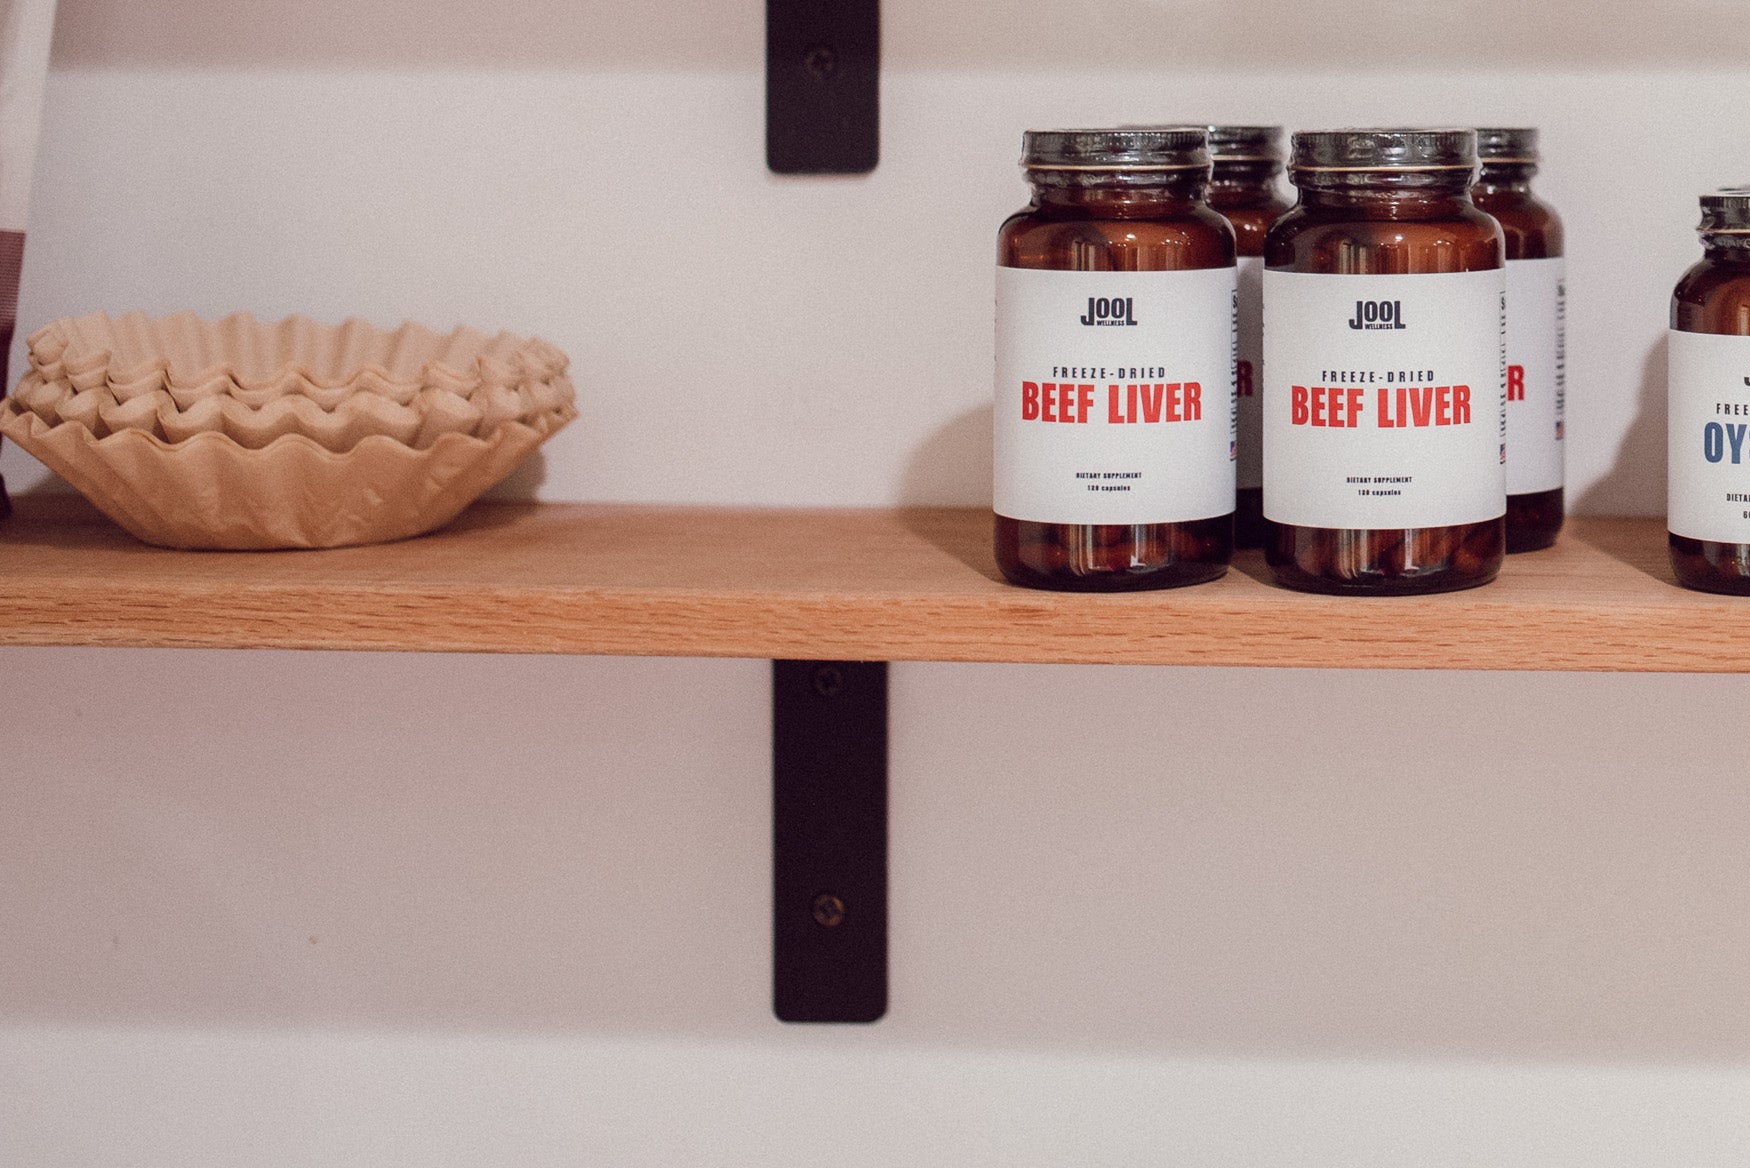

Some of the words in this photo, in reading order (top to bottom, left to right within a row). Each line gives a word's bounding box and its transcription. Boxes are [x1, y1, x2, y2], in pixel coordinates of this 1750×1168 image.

[1080, 297, 1138, 326] JOOL
[1348, 300, 1406, 329] JOOL
[1053, 367, 1166, 379] FREEZE-DRIED
[1322, 370, 1434, 383] FREEZE-DRIED
[1022, 381, 1095, 424] BEEF
[1108, 381, 1202, 424] LIVER
[1291, 384, 1364, 428] BEEF
[1377, 384, 1471, 428] LIVER
[1372, 489, 1402, 497] capsules
